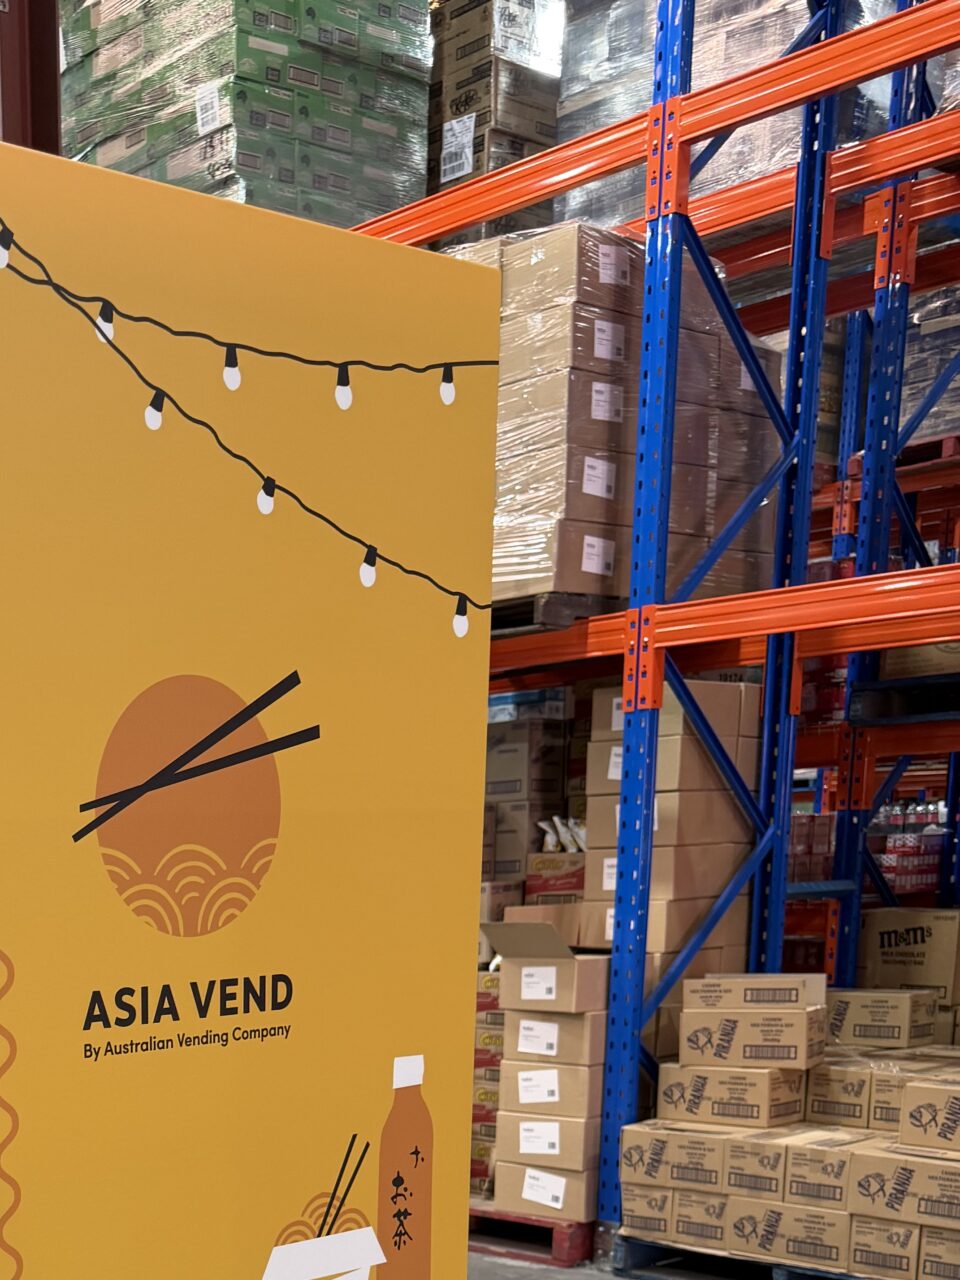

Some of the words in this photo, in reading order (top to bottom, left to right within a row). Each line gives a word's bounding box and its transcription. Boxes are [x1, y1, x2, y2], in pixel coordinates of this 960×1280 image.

[82, 984, 180, 1030] ASIA
[189, 973, 293, 1018] VEND
[84, 1043, 101, 1062] By
[104, 1036, 174, 1057] Australian
[177, 1029, 229, 1047] Vending
[232, 1024, 292, 1042] Company
[885, 1166, 916, 1213] PIRANHA
